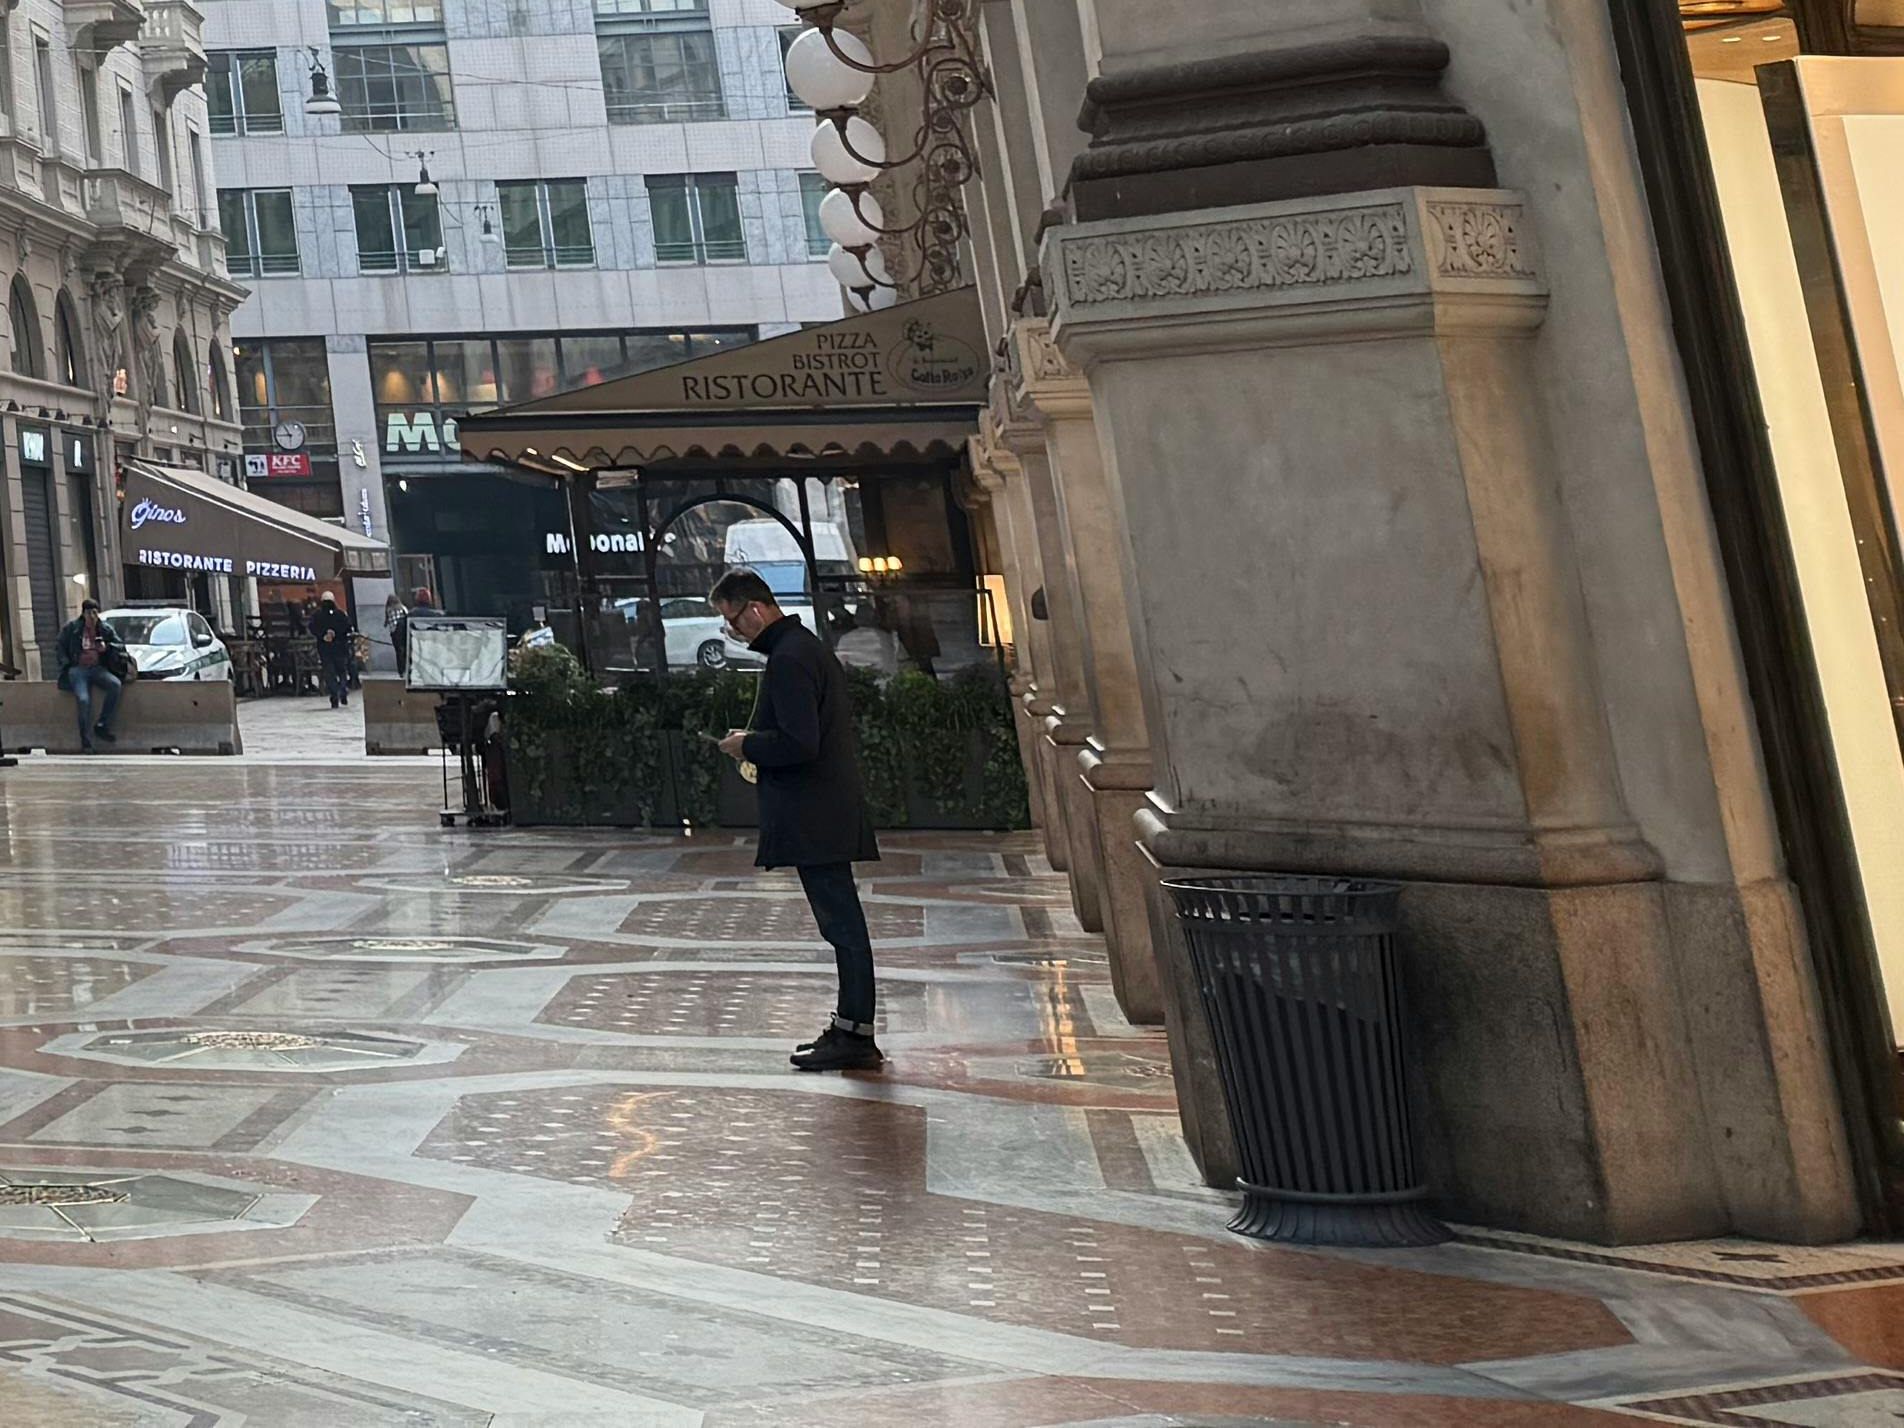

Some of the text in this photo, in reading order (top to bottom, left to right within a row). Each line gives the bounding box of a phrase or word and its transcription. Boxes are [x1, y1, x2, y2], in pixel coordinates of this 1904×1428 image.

[816, 332, 877, 350] PIZZA
[793, 351, 881, 370] BISTROT
[682, 371, 887, 401] RISTORANTE
[272, 454, 301, 467] KFC
[139, 549, 316, 581] RISTORANTE PIZZERIA
